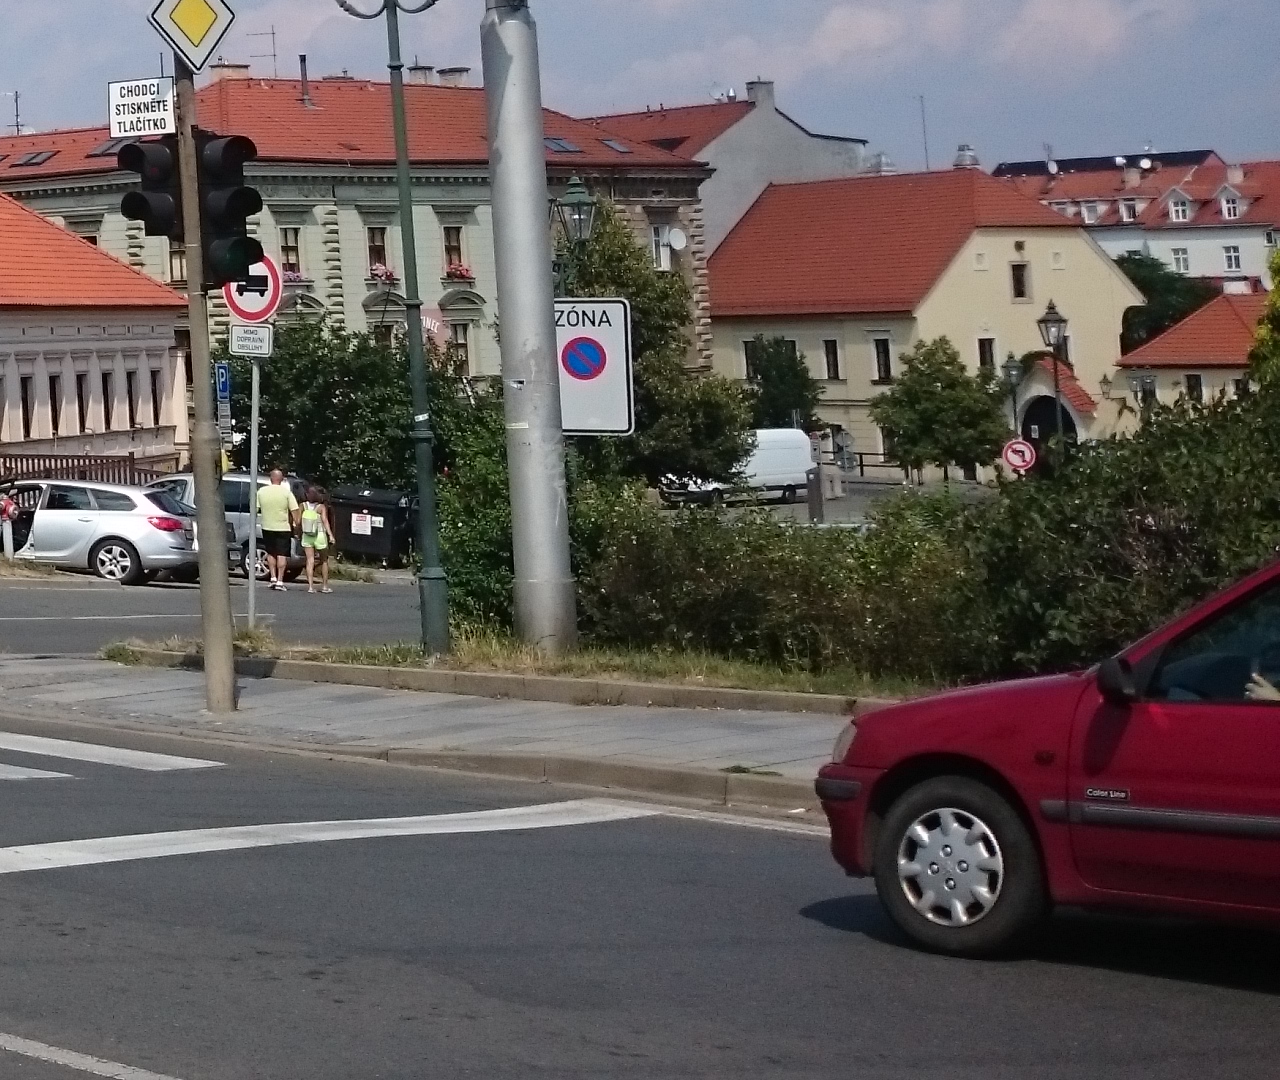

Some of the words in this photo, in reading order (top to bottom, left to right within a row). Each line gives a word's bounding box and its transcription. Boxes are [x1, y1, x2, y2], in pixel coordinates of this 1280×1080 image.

[119, 82, 160, 98] CHODCI
[115, 98, 168, 116] STISKNĚTE
[116, 117, 167, 133] TLAČÍTKO
[554, 306, 613, 328] ZÓNA
[219, 368, 227, 391] P
[1086, 788, 1108, 797] Color
[1109, 790, 1126, 798] Line
